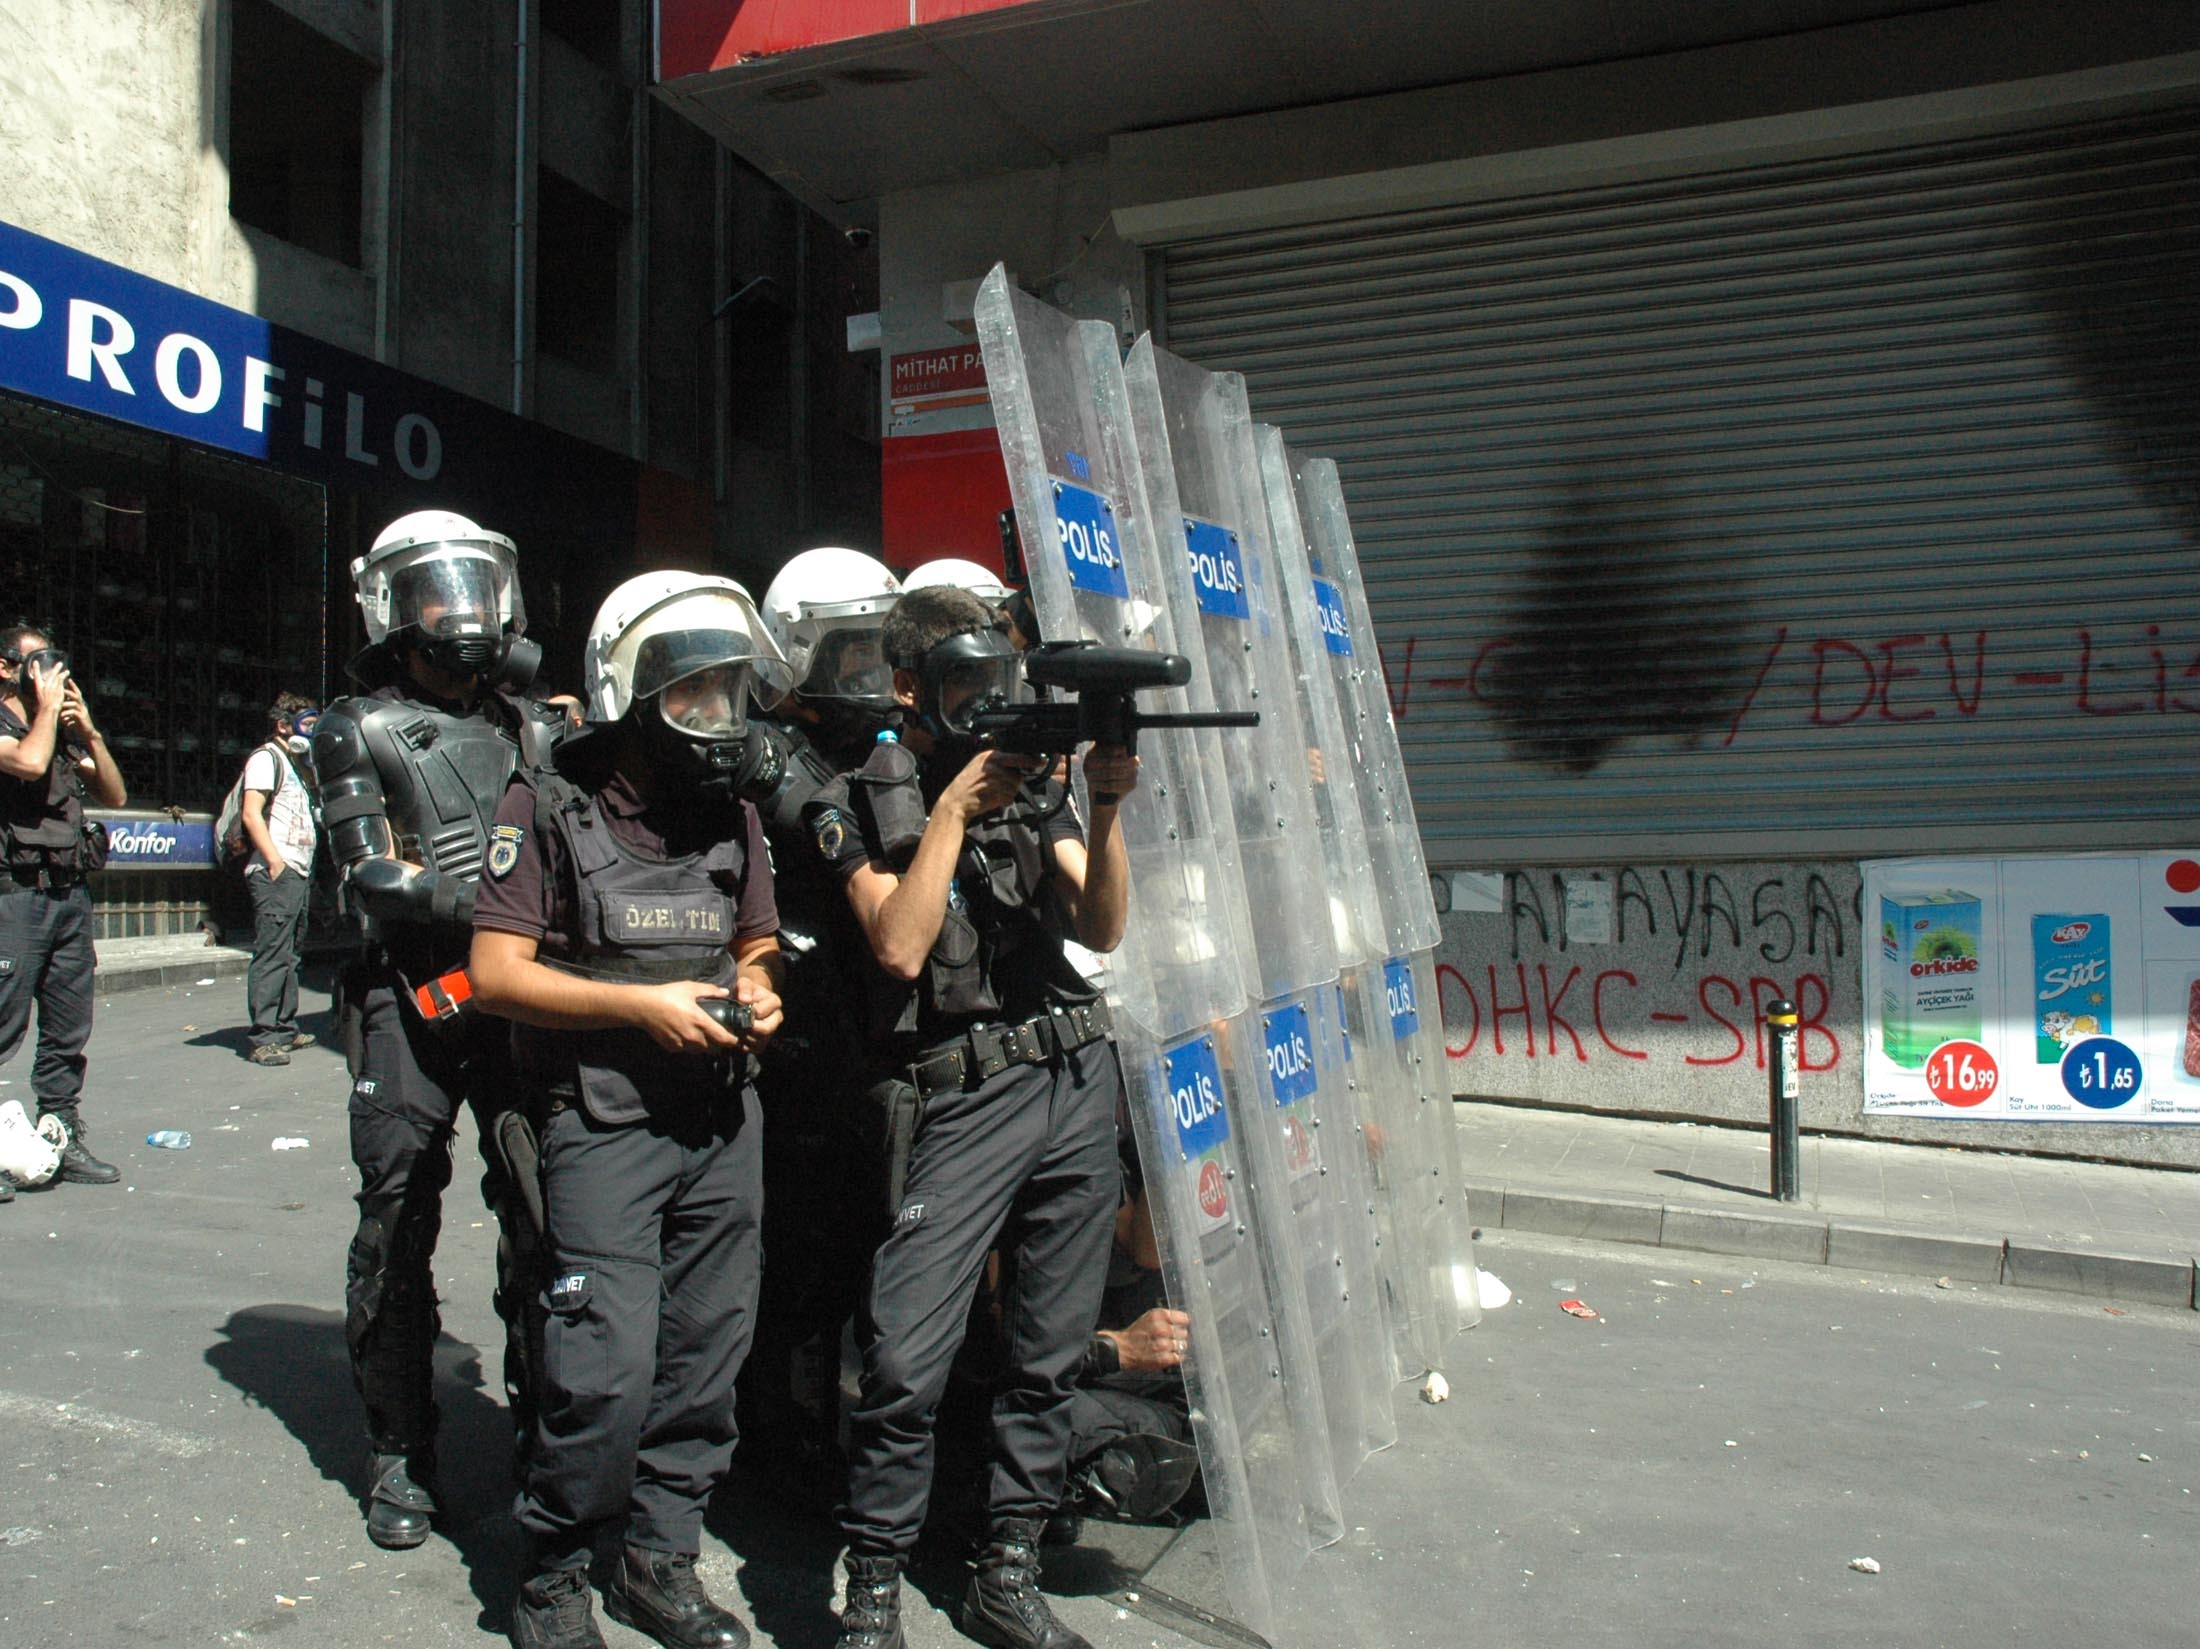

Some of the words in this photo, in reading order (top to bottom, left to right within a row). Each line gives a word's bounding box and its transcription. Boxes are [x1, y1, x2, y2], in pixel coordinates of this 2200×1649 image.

[896, 355, 959, 379] MİTHAT
[964, 351, 987, 370] PA
[1317, 603, 1343, 636] OLİS
[109, 831, 176, 854] Konfor
[2056, 926, 2086, 940] KAY
[1910, 957, 1979, 978] orkide
[2039, 959, 2107, 1000] Süt
[1387, 976, 1411, 1017] OLİS
[2009, 1096, 2024, 1105] Kay
